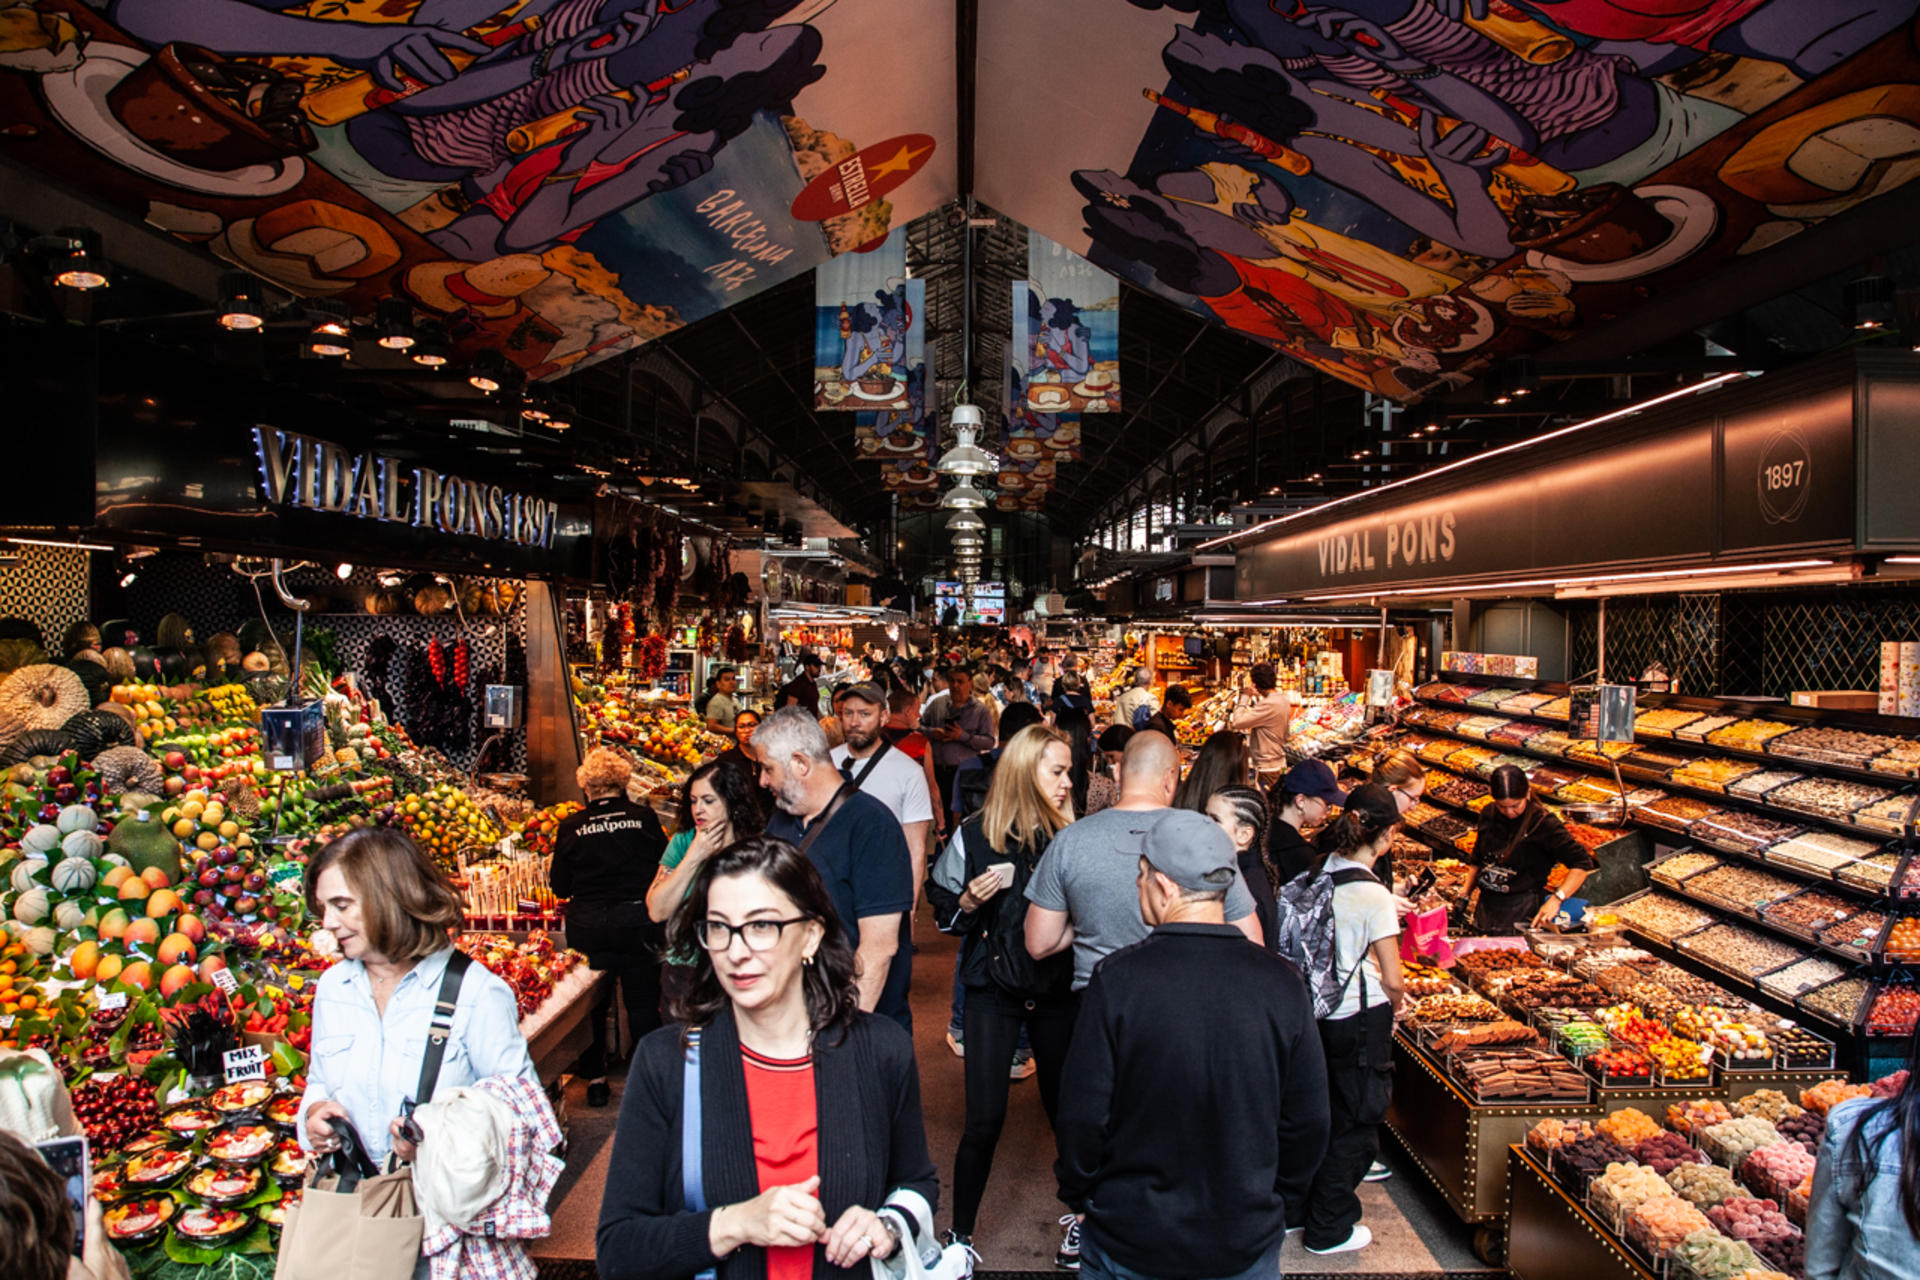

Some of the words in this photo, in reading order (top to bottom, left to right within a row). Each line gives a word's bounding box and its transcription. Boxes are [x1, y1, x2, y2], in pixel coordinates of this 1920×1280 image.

[838, 155, 870, 209] ESTRELLA
[696, 189, 793, 266] BARCELONA
[251, 423, 410, 523] VIDAL
[411, 467, 503, 541] PONS
[504, 491, 559, 551] 1897
[1764, 460, 1804, 491] 1897
[1318, 530, 1375, 577] VIDAL
[1386, 511, 1456, 568] PONS
[575, 819, 643, 837] vidalpons
[226, 1062, 262, 1079] FRUIT
[229, 1048, 258, 1062] MIX
